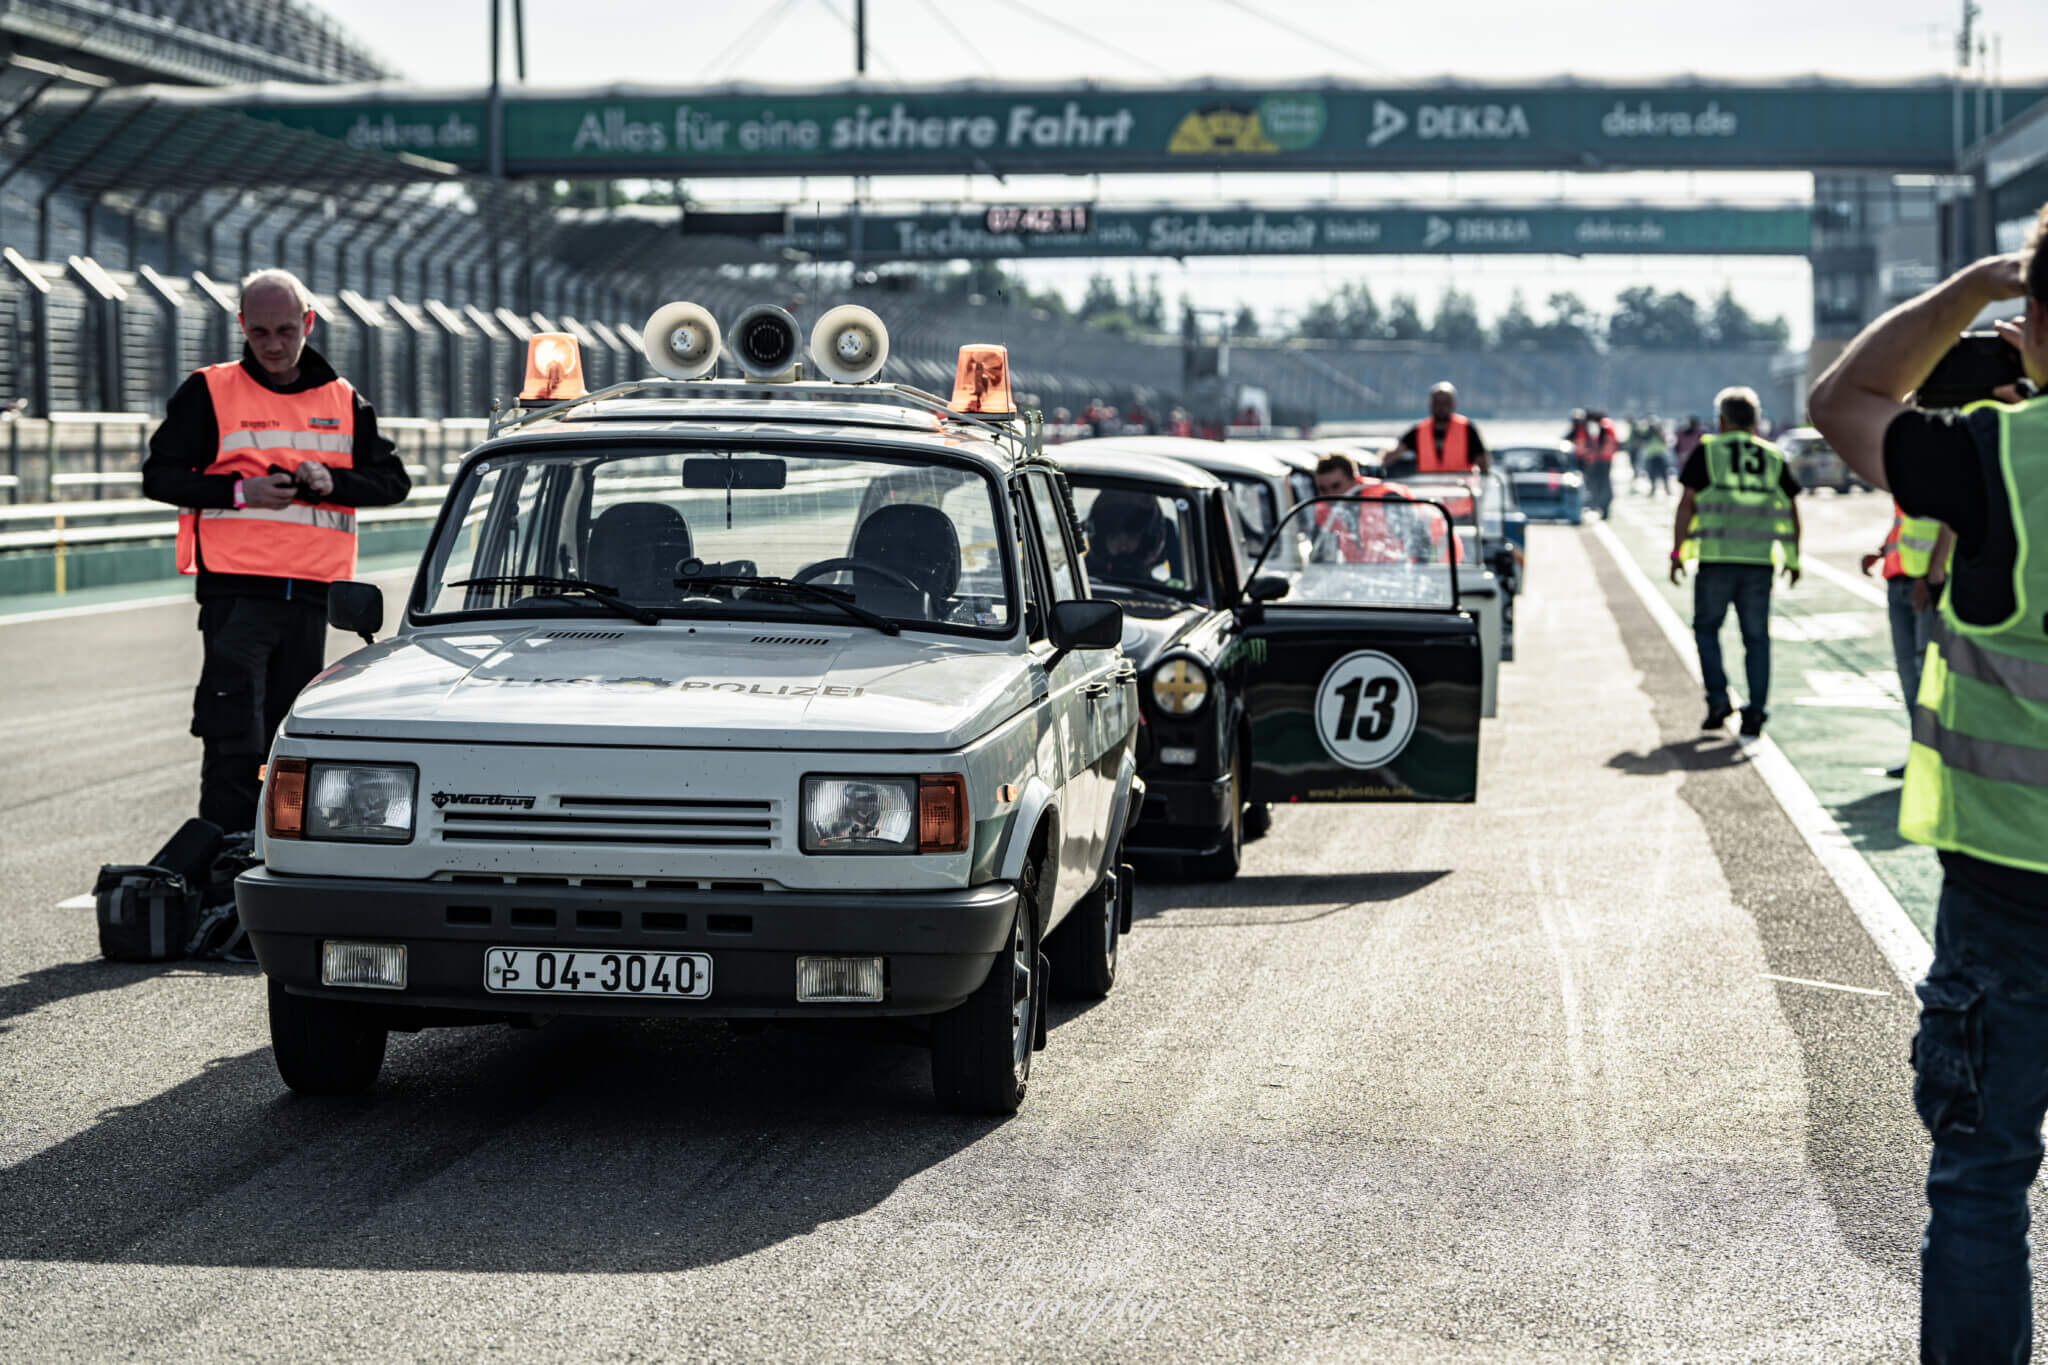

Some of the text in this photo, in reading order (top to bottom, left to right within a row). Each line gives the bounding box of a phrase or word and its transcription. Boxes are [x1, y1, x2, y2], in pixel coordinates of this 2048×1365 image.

[573, 104, 1134, 152] Alles für eine sichere Fahrt
[1417, 104, 1530, 139] DEKRA
[1602, 101, 1738, 137] dekra.de
[1149, 213, 1316, 249] Sicherheit
[1454, 218, 1531, 243] DEKRA
[1724, 439, 1766, 475] 13
[680, 681, 865, 697] POLIZEI
[1334, 676, 1400, 743] 13
[449, 793, 537, 810] Wartburg
[502, 952, 518, 968] V
[535, 952, 697, 994] 04-3040
[502, 969, 520, 988] P
